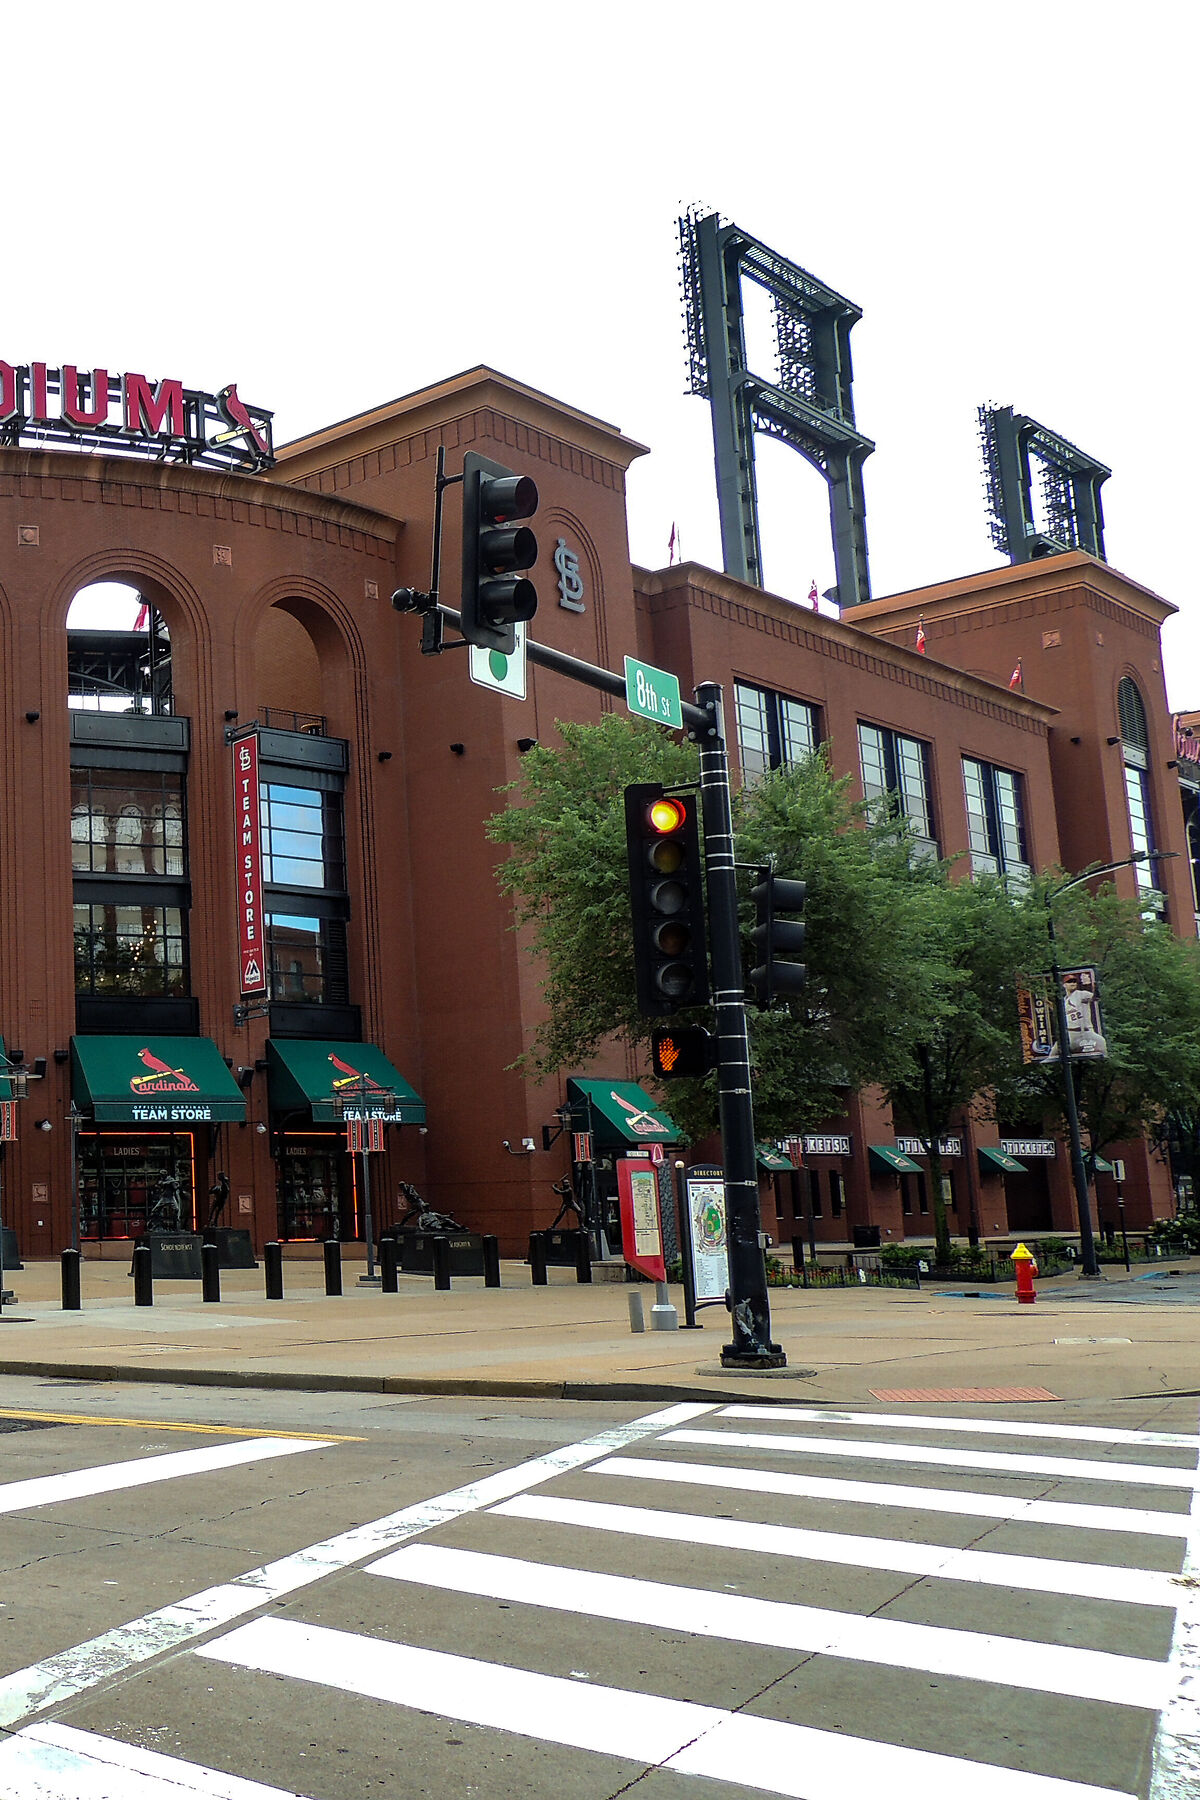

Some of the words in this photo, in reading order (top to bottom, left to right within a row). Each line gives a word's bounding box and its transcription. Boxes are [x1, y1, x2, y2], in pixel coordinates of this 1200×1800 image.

[635, 669, 658, 713] 8th
[242, 778, 253, 847] TEAM
[244, 854, 255, 941] STORE
[1070, 1011, 1084, 1021] 22
[130, 1076, 200, 1095] Cardinals
[132, 1109, 168, 1120] TEAM
[171, 1109, 211, 1120] STORE
[113, 1147, 140, 1156] LADIES
[286, 1148, 307, 1156] LADIES
[1008, 1141, 1049, 1154] TICKETS
